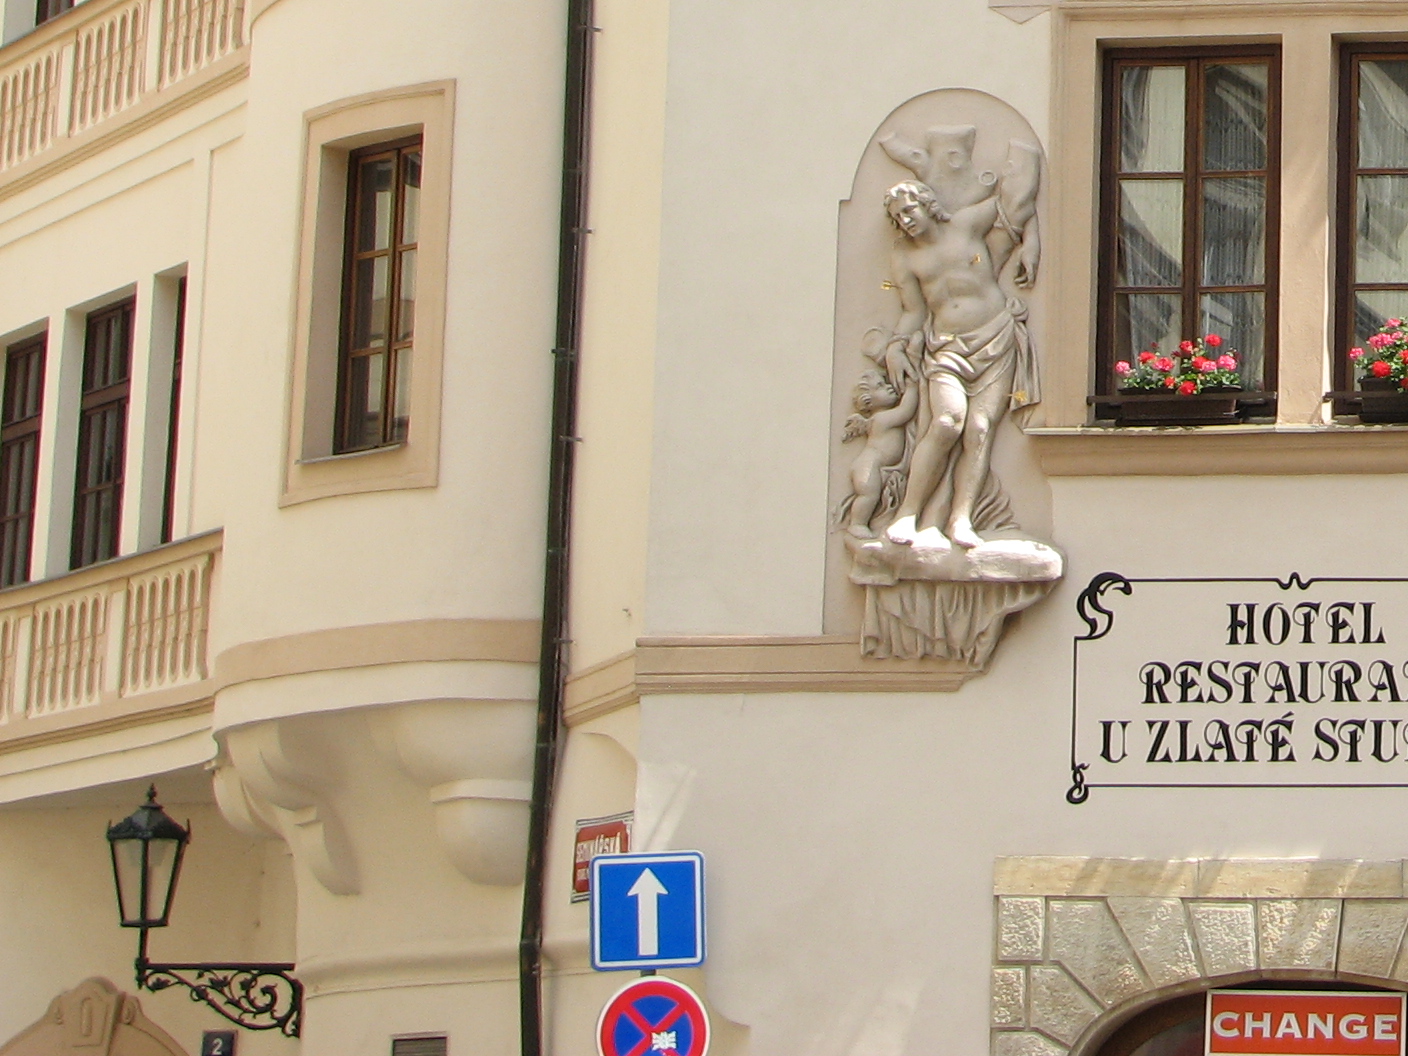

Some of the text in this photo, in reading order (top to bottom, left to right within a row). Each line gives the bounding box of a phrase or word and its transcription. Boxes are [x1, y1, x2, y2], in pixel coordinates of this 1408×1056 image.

[1226, 601, 1386, 645] HOTEL
[1099, 720, 1132, 763] U
[1145, 712, 1296, 763] ZLATÉ
[1213, 1011, 1398, 1041] CHANGE
[212, 1037, 223, 1055] 2
